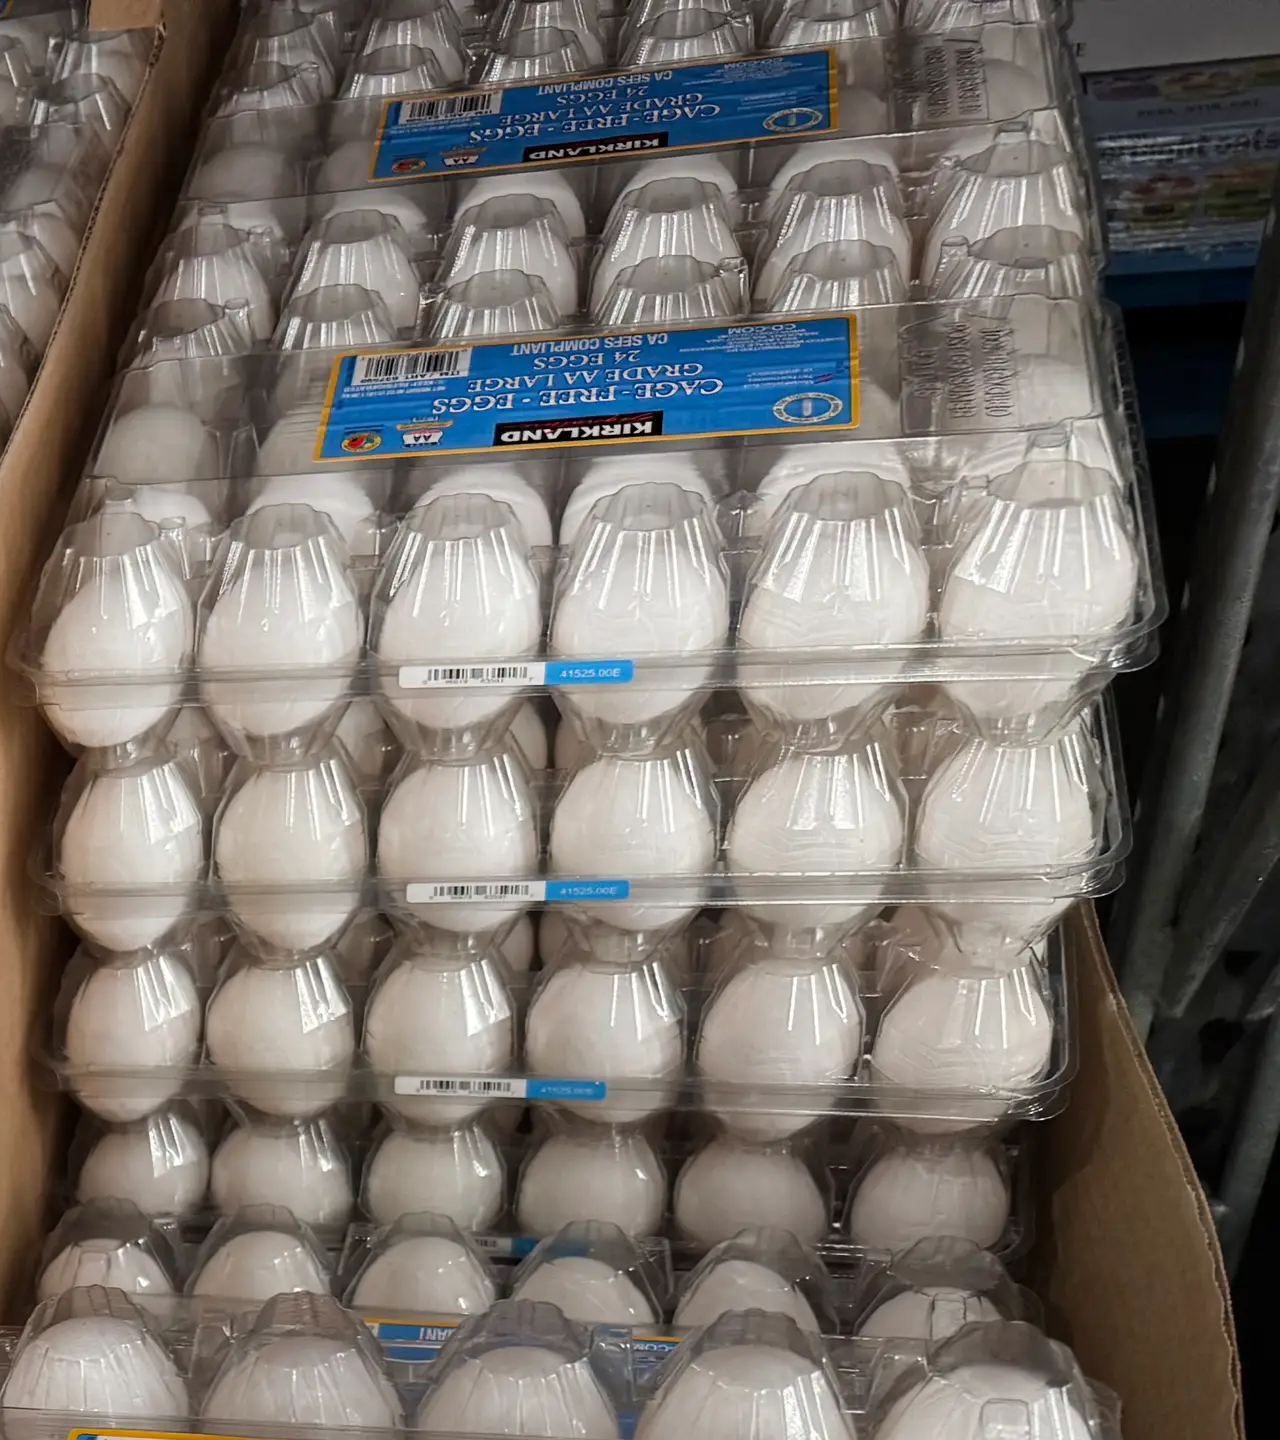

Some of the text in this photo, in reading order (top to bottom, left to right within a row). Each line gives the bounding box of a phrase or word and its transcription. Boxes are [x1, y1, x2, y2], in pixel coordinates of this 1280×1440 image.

[654, 70, 673, 82] CA
[535, 76, 614, 95] COMPLIANT
[556, 86, 649, 105] 24 EGGS
[499, 93, 703, 126] GRADE AA LARGE
[467, 126, 540, 143] EGGS
[528, 139, 660, 159] KIRKLAND
[510, 338, 600, 356] COMPLIANT
[604, 335, 643, 348] SEFS
[647, 332, 668, 344] CA
[534, 350, 641, 370] 24 EGGS
[565, 369, 599, 383] AA
[605, 363, 703, 382] GRADE
[467, 374, 554, 392] LARGE
[432, 378, 724, 414] CAGE-FREE EGGS
[413, 434, 432, 442] AA
[500, 421, 653, 442] KIRKLAND
[559, 667, 621, 679] 41525.00E
